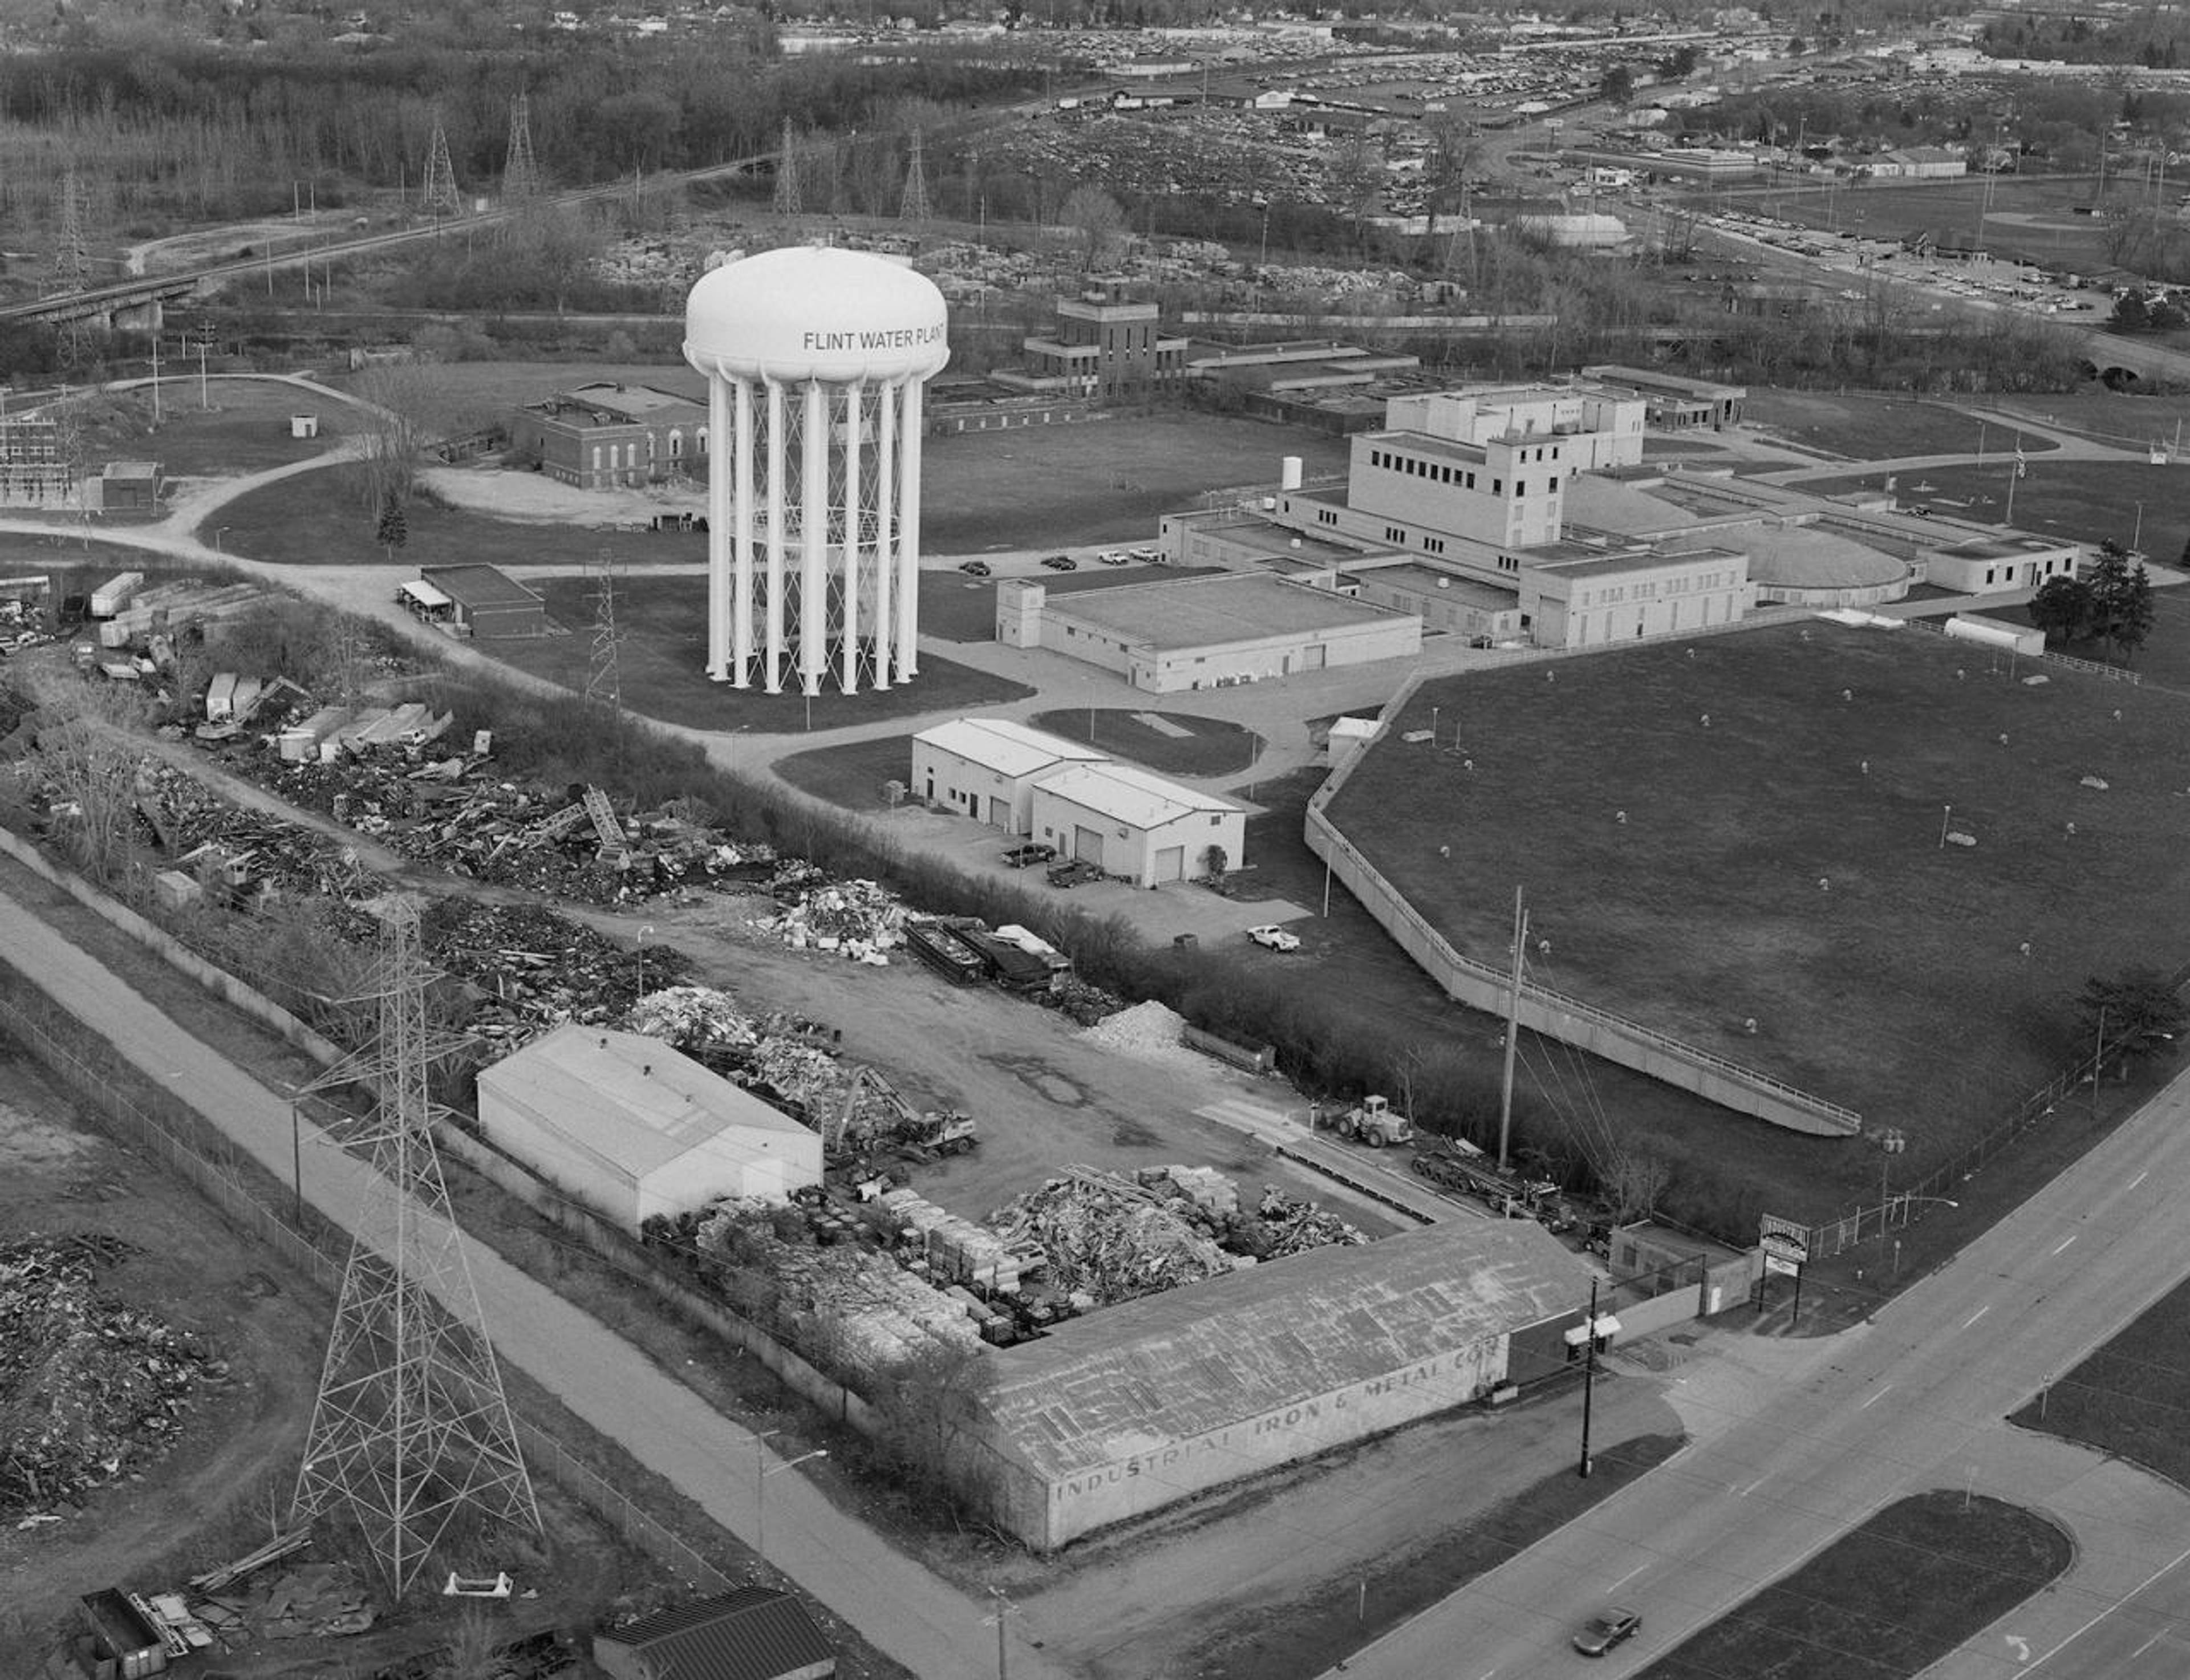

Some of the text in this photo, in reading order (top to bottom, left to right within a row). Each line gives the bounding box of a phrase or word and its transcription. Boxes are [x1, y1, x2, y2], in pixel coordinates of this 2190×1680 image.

[804, 322, 944, 350] FLINT WATER PLANT
[1057, 1430, 1231, 1501] INDUSTRIAL
[1255, 1401, 1320, 1435] IRON
[1365, 1362, 1439, 1396] METAL
